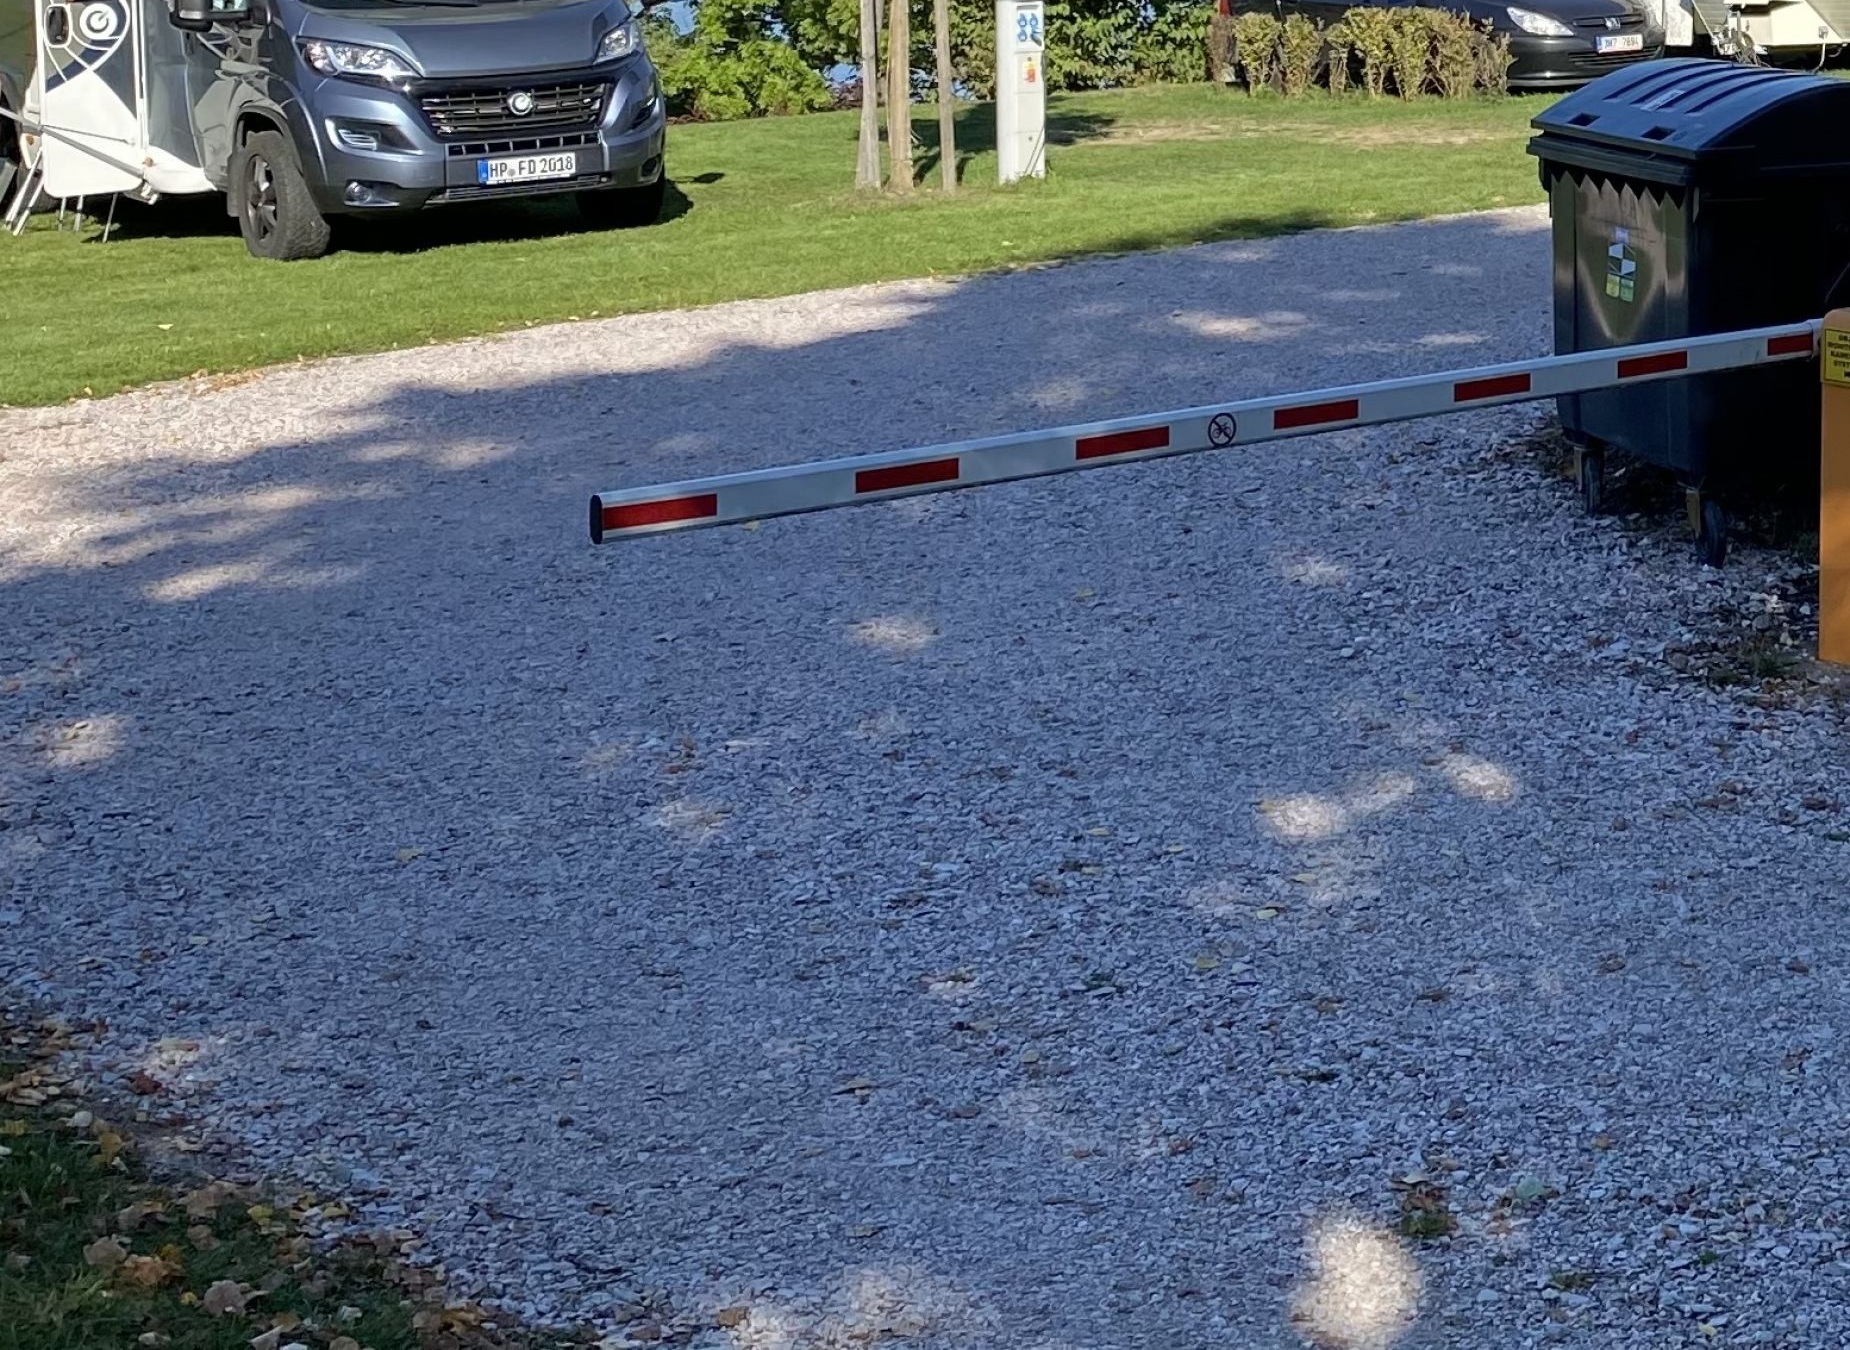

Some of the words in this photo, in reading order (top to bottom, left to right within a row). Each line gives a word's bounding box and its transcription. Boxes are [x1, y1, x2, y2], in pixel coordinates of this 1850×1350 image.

[489, 162, 508, 178] HP
[518, 159, 537, 176] FD
[540, 155, 574, 174] 2018
